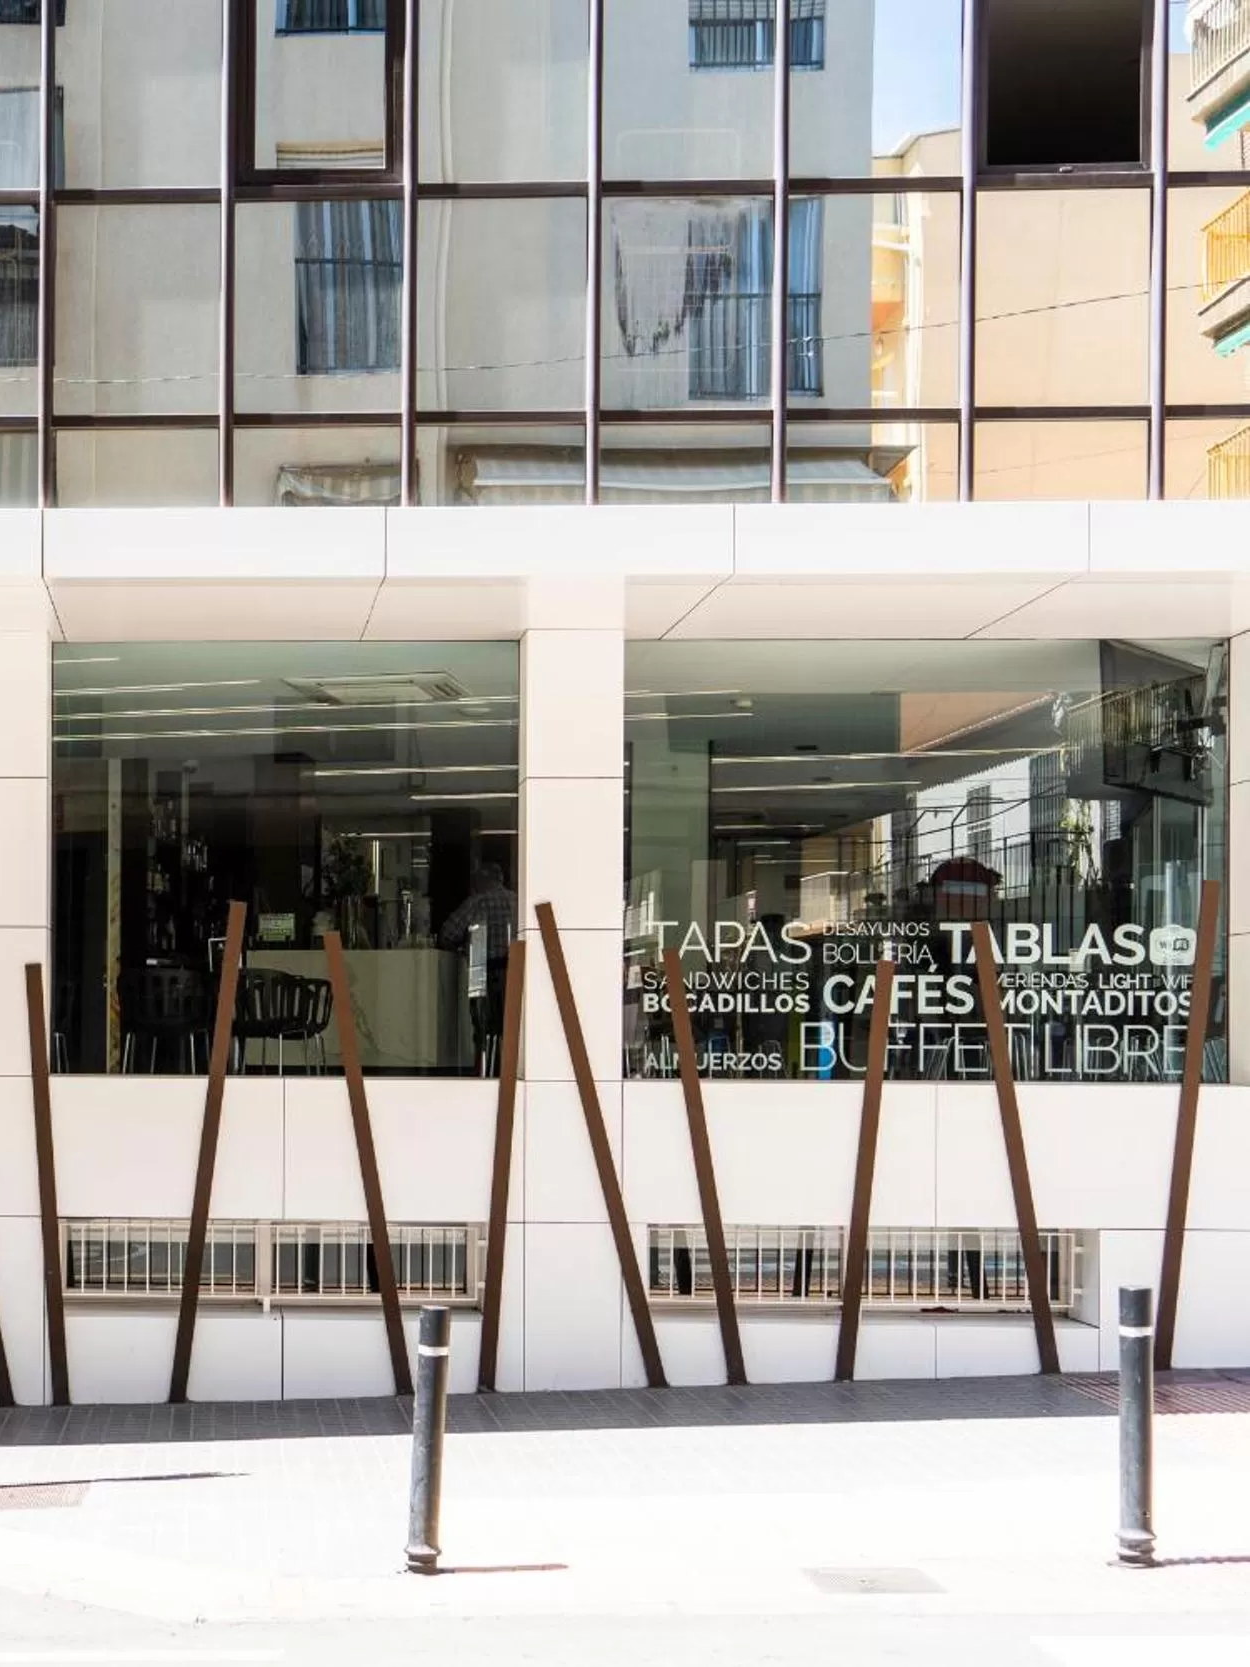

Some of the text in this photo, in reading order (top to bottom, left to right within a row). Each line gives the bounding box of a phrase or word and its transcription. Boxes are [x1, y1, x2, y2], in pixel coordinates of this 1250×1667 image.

[644, 921, 812, 964] TAPAS
[822, 922, 930, 937] DESAYUNOS
[939, 922, 1147, 966] TABLAS
[822, 963, 974, 1015] CAFÉS
[1099, 973, 1152, 989] LIGHT
[1161, 974, 1194, 989] WIF
[1045, 1023, 1188, 1074] LIBRE
